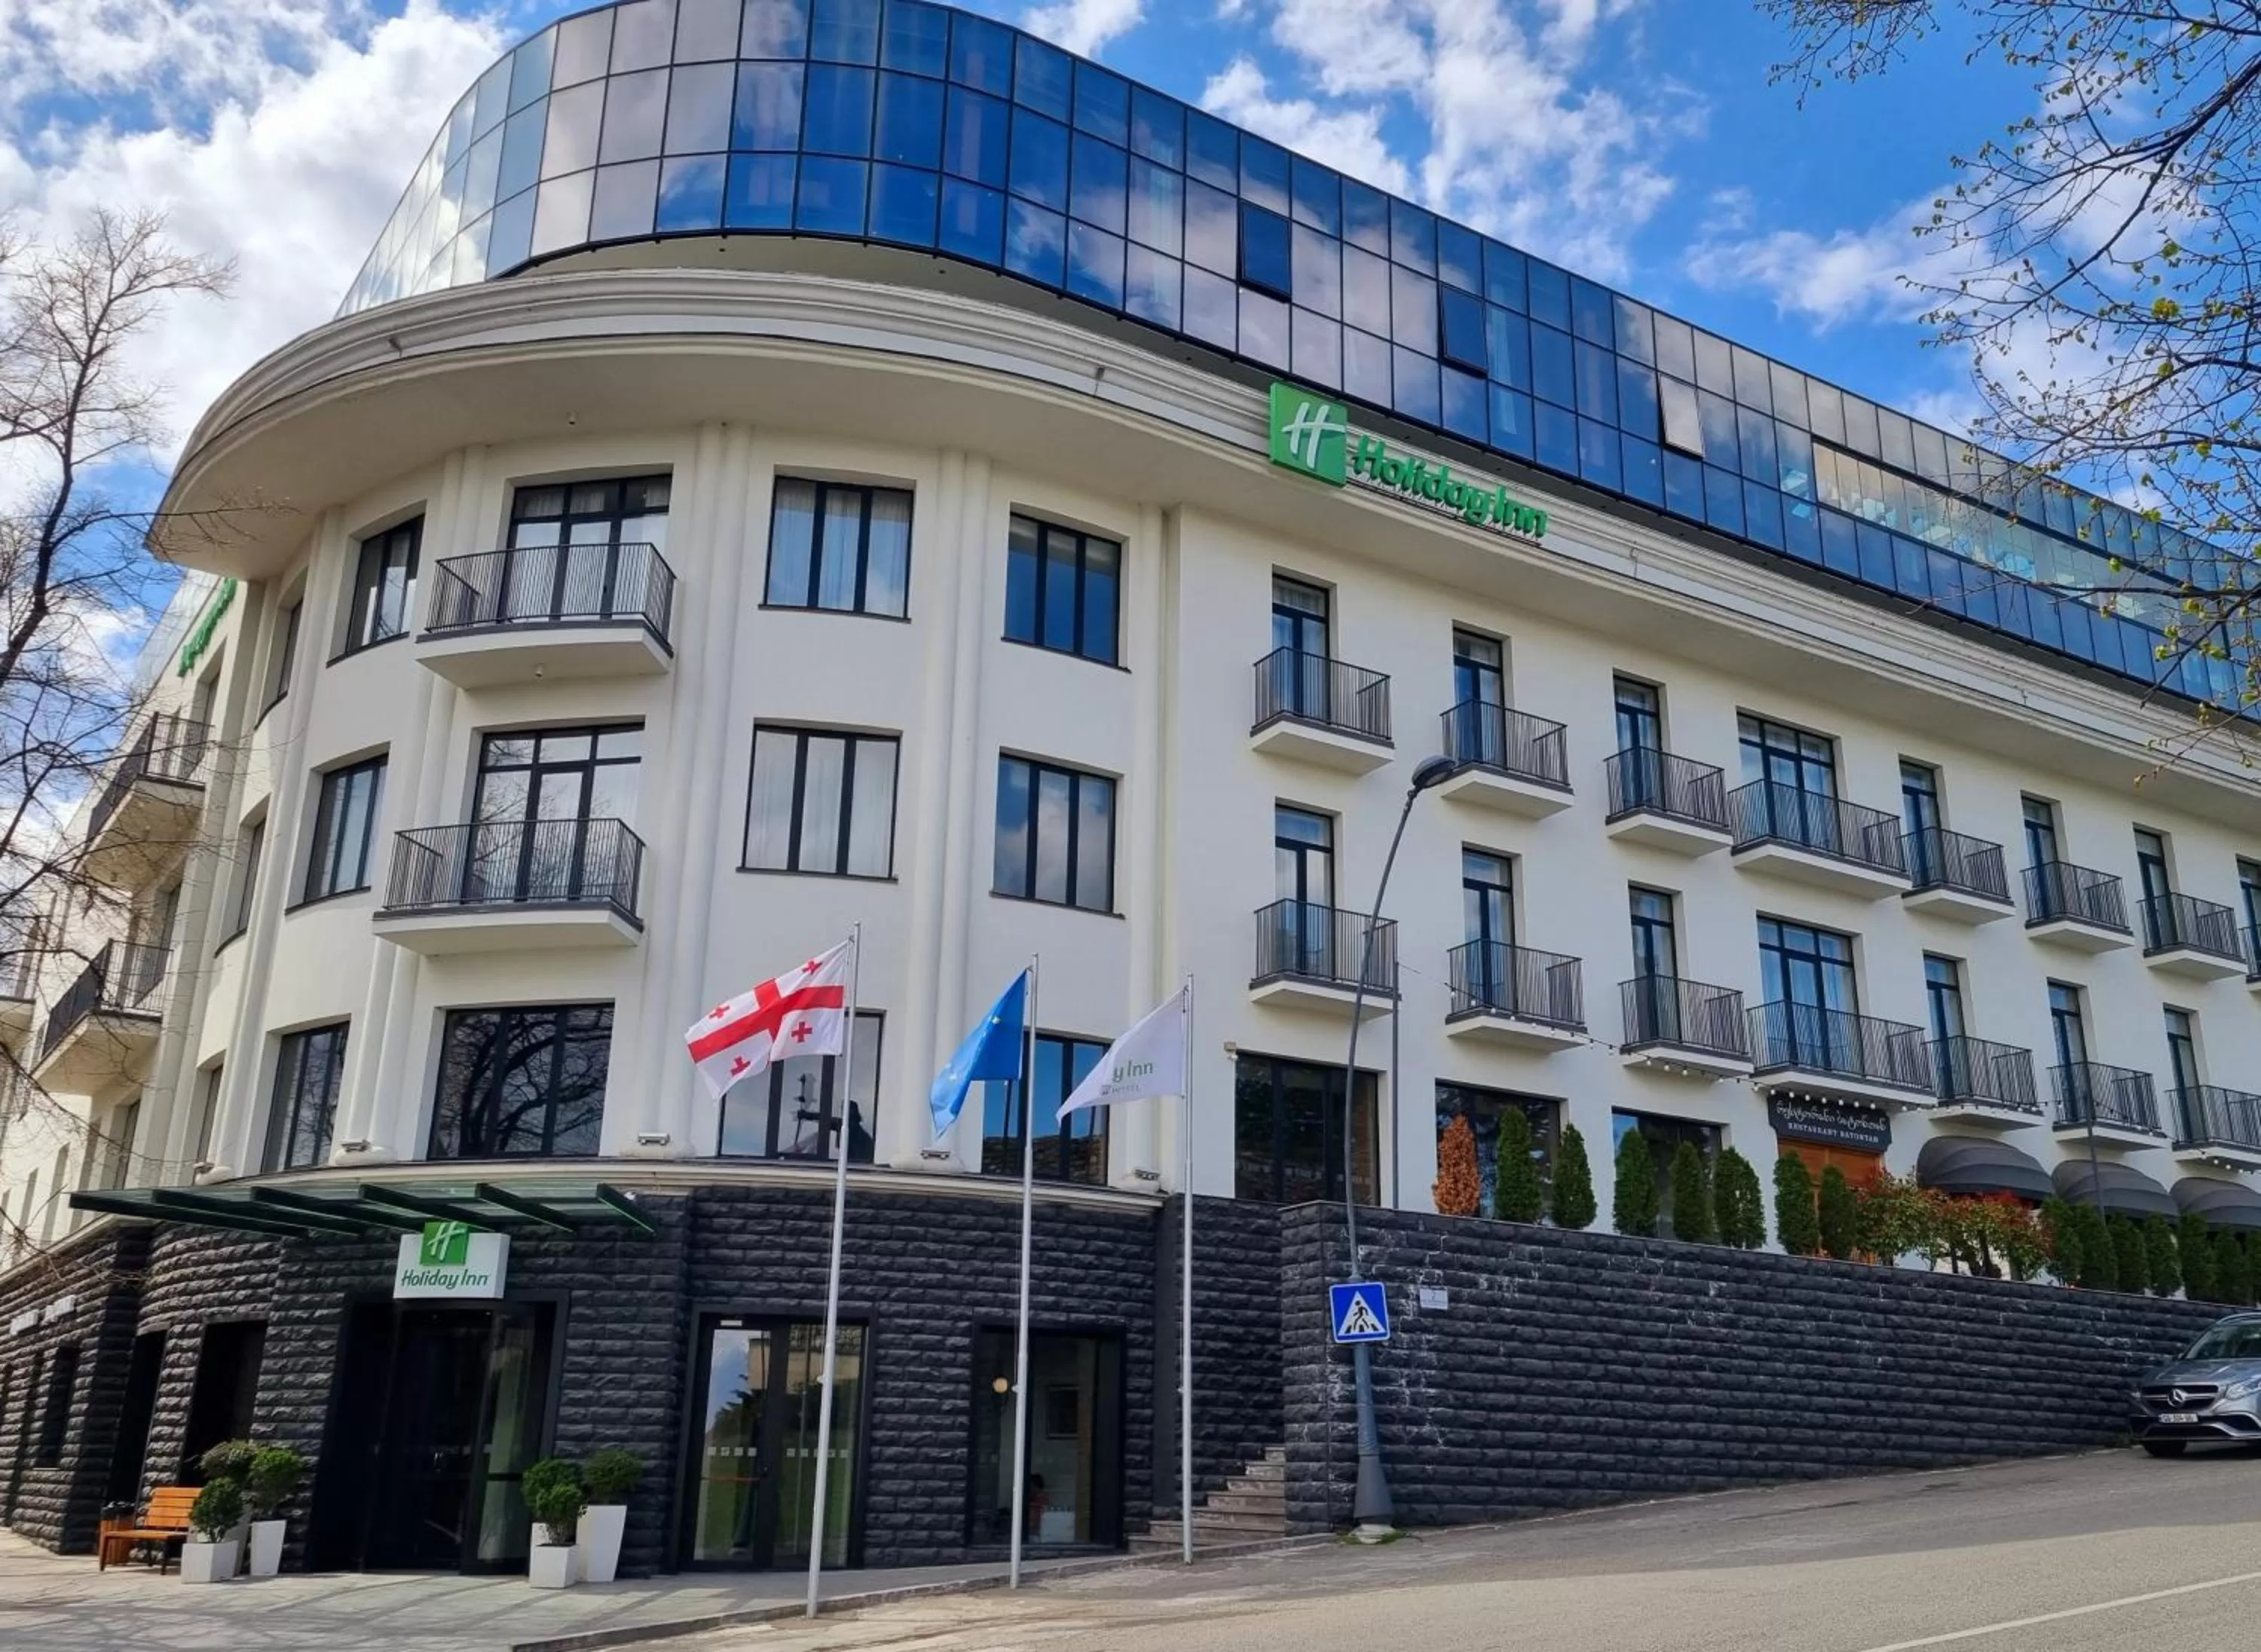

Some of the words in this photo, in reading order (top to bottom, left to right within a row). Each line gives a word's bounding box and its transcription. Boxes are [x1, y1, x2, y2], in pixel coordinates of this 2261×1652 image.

[1353, 434, 1491, 525] Holiday
[1492, 484, 1549, 538] Inn
[1127, 1060, 1153, 1077] Inn
[401, 1268, 458, 1289] Holiday
[460, 1268, 489, 1286] Inn
